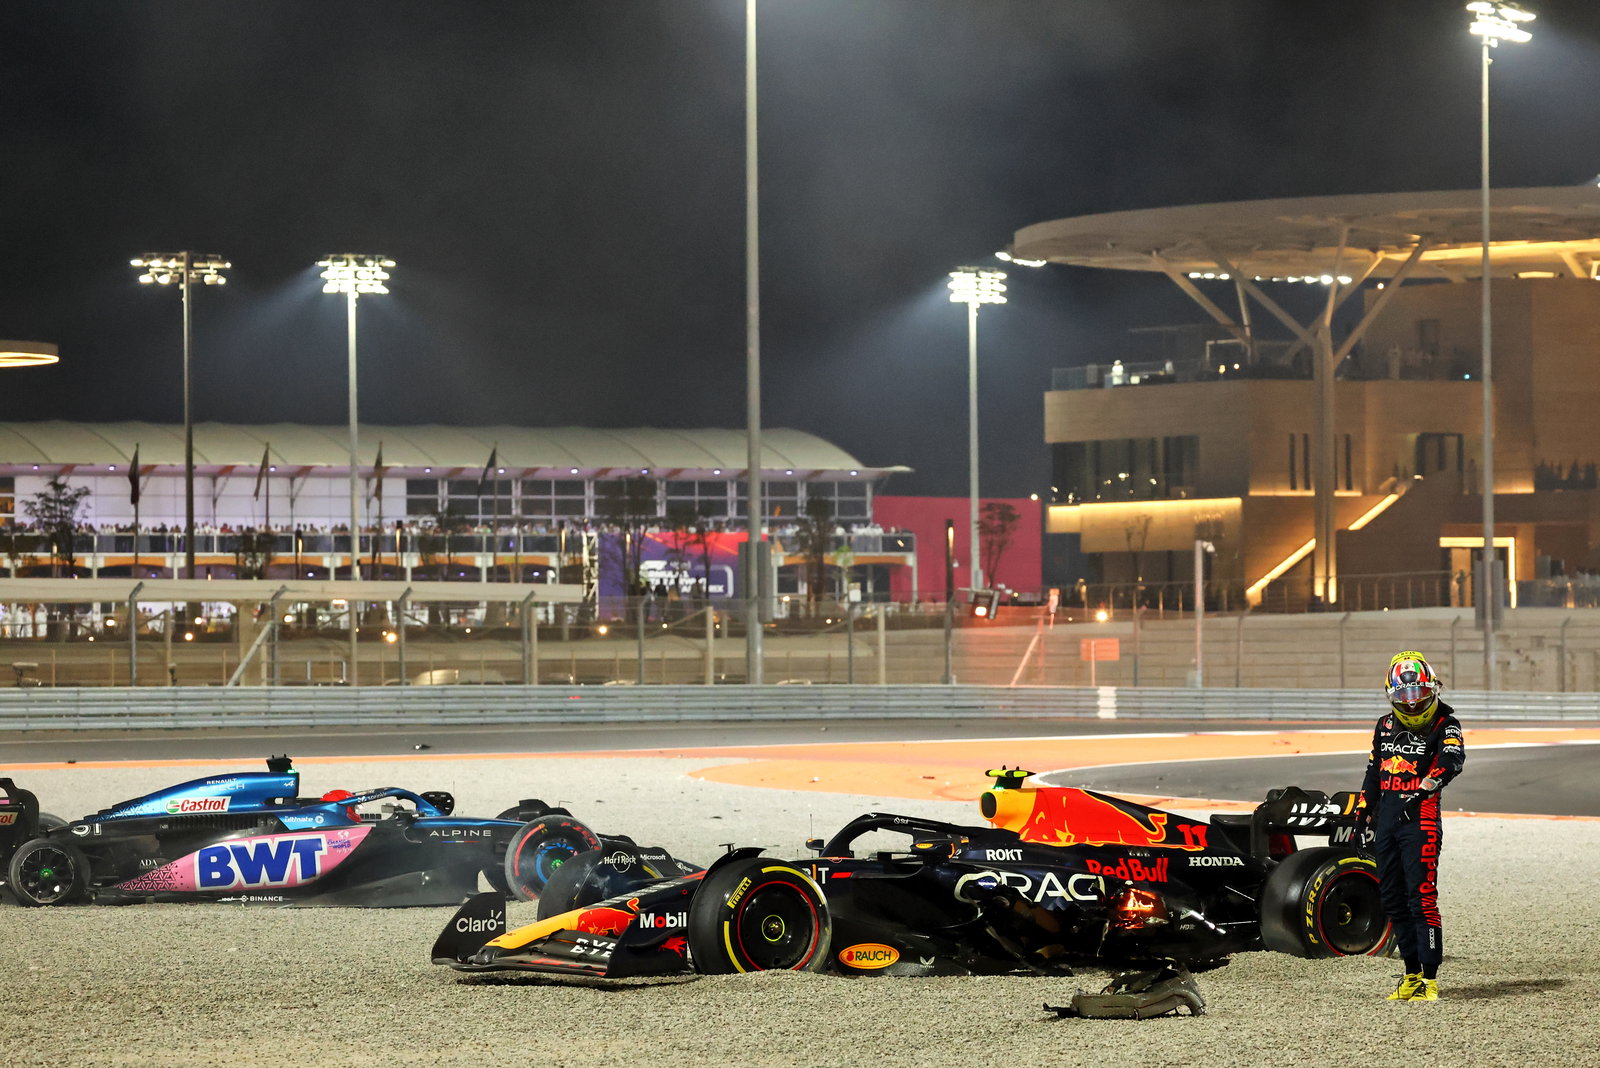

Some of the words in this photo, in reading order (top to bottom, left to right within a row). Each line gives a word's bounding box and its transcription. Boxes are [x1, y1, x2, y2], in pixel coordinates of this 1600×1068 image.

[1396, 682, 1424, 690] ORACLE
[1381, 742, 1426, 755] ORACLE
[180, 798, 226, 812] Castrol
[1176, 824, 1208, 847] 11
[640, 853, 666, 861] Microsoft
[986, 849, 1023, 862] ROKT
[1188, 856, 1245, 867] HONDA
[198, 838, 324, 888] BWT
[727, 876, 752, 909] PIRELLI
[1306, 876, 1323, 929] ZERO
[456, 917, 498, 933] Claro
[639, 911, 687, 929] Mobil
[855, 951, 892, 961] RAUCH
